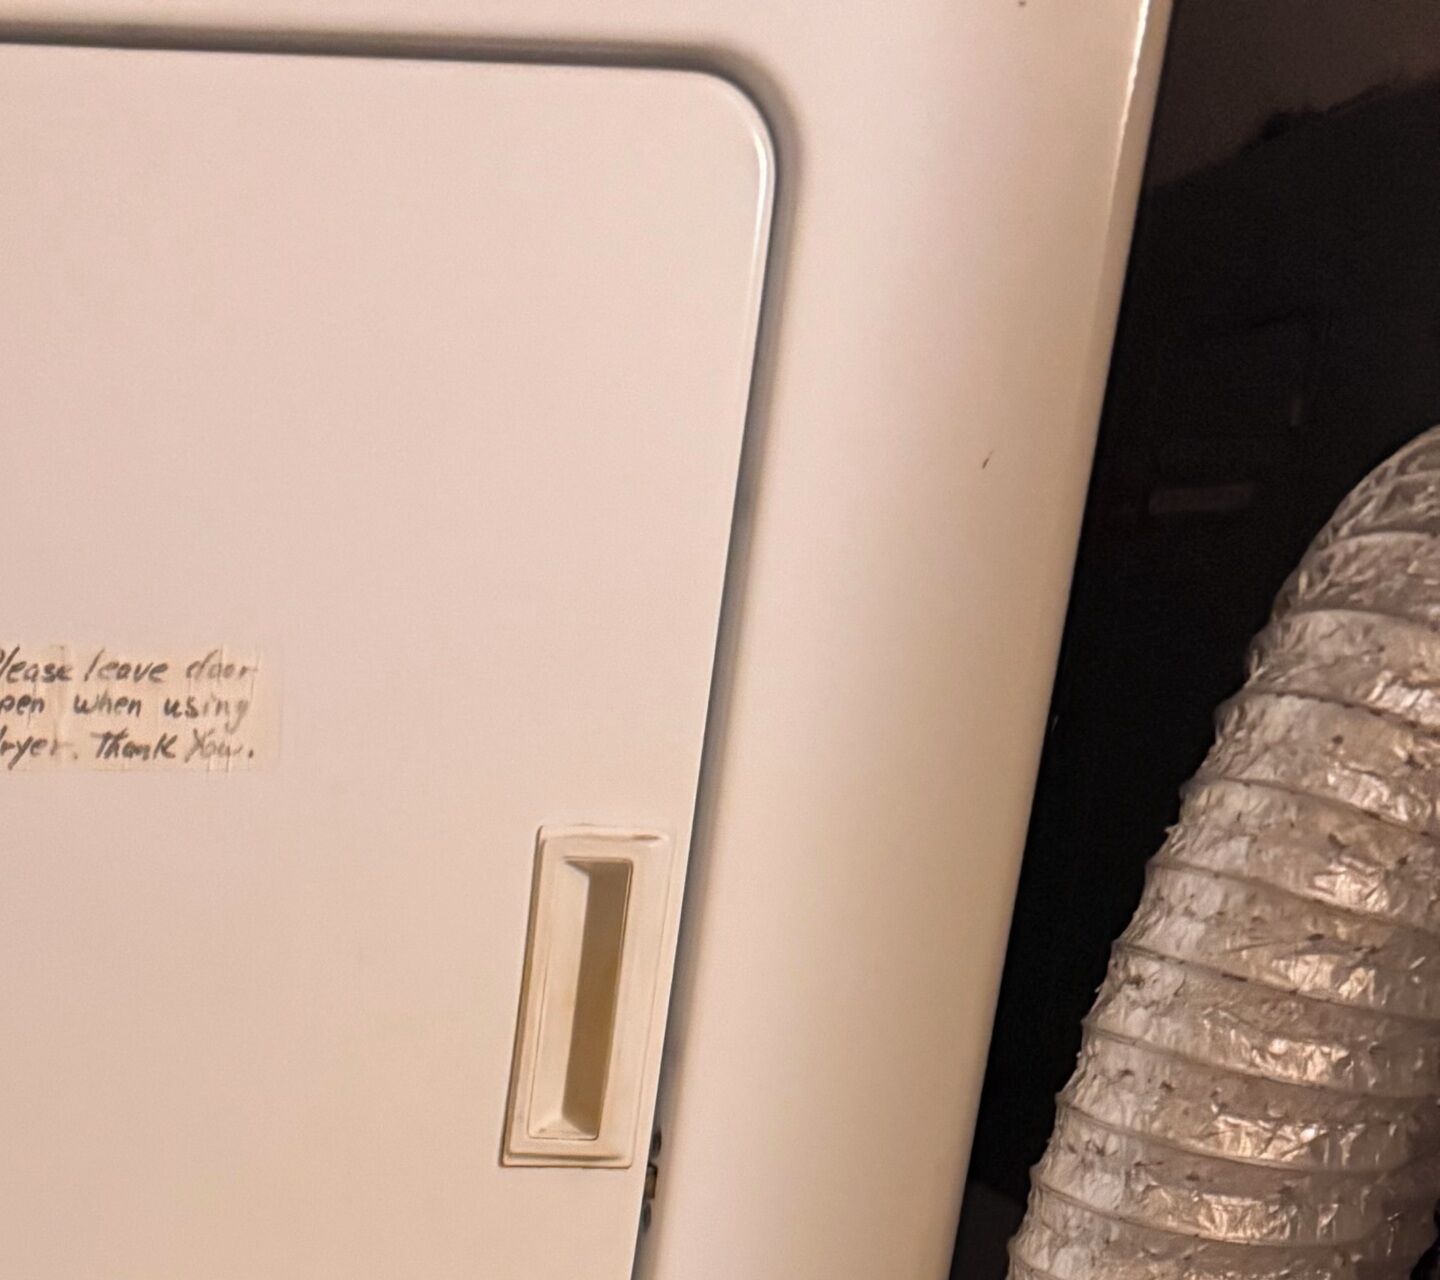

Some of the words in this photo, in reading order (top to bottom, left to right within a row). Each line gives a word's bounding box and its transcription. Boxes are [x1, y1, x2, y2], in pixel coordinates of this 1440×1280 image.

[83, 649, 168, 683] leave
[73, 692, 142, 718] when
[163, 695, 251, 734] using
[90, 728, 178, 760] Thank
